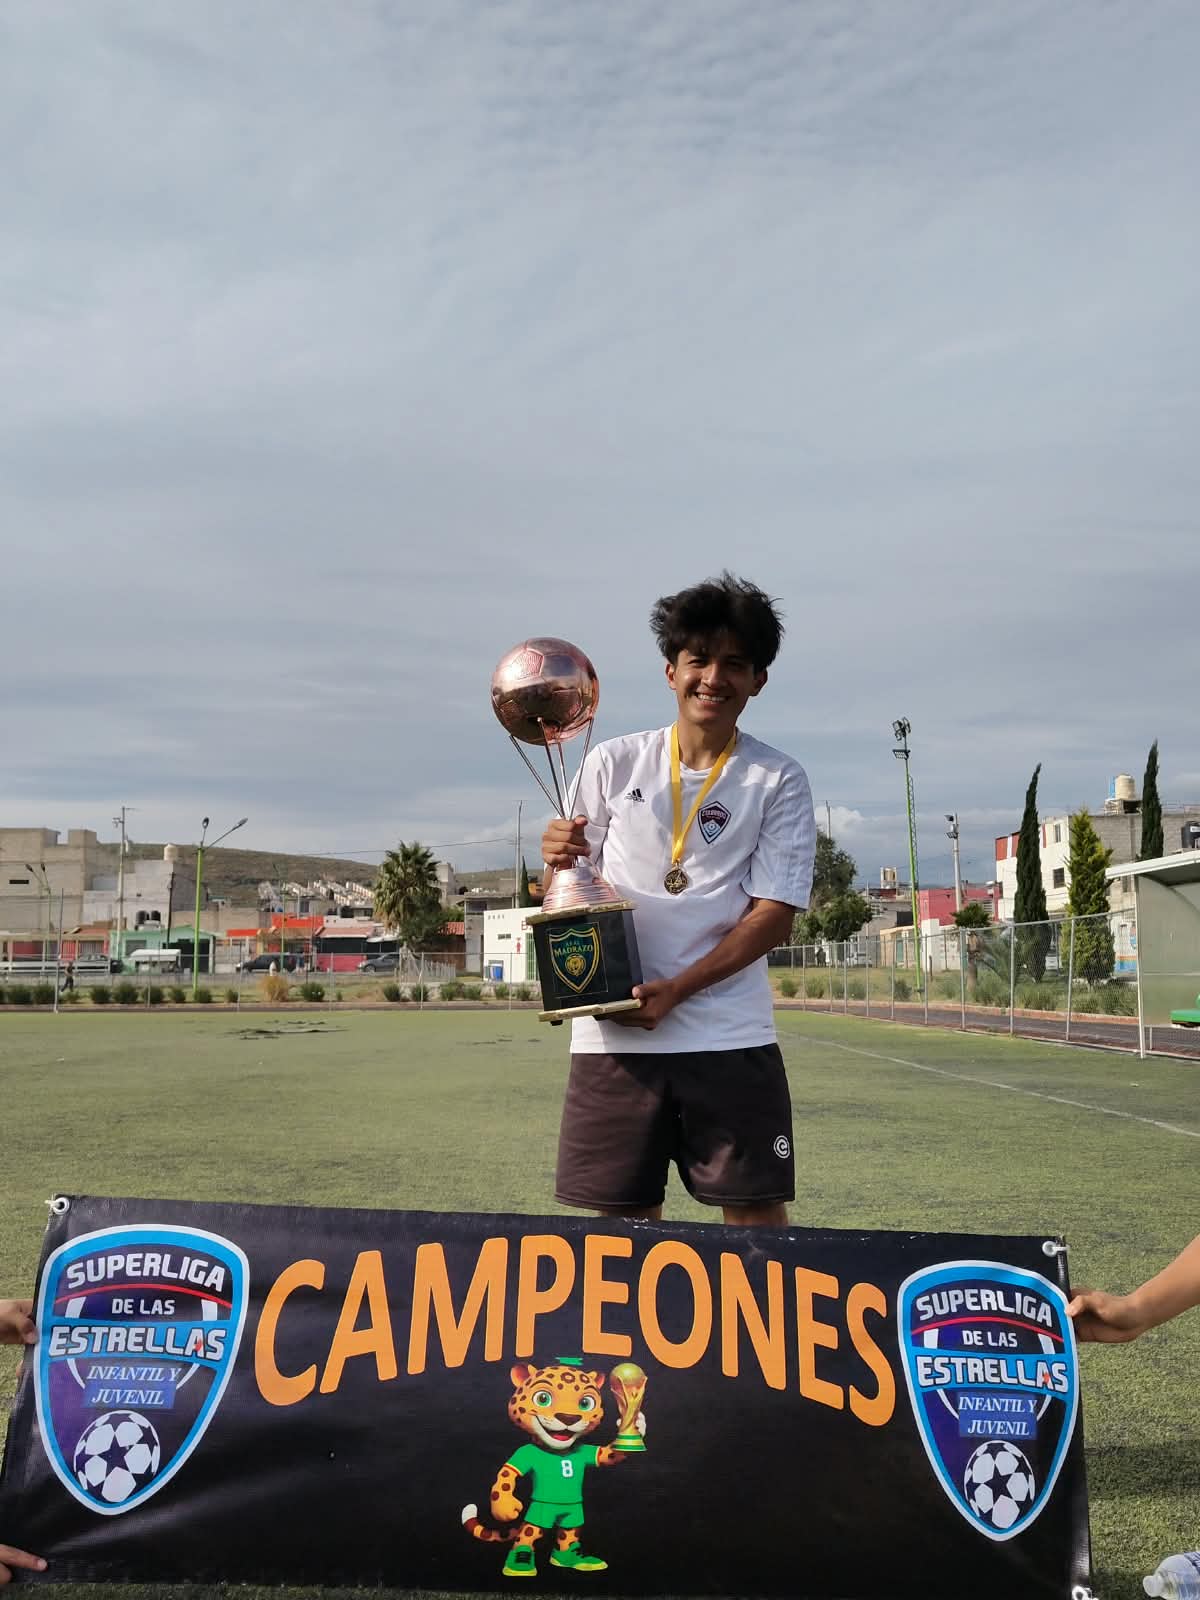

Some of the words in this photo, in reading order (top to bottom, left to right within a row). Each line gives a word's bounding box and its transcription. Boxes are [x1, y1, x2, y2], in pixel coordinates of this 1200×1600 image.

[66, 1253, 225, 1292] SUPERLIGA
[112, 1298, 134, 1314] DE
[140, 1299, 175, 1315] LAS
[916, 1289, 1052, 1327] SUPERLIGA
[254, 1234, 896, 1426] CAMPEONES
[963, 1330, 984, 1346] DE
[988, 1332, 1018, 1348] LAS
[49, 1326, 227, 1361] ESTRELLAS
[87, 1366, 166, 1381] INFANTIL
[167, 1367, 182, 1382] Y
[916, 1356, 1069, 1393] ESTRELLAS
[91, 1389, 164, 1405] JUVENIL
[958, 1396, 1026, 1413] INFANTIL
[1026, 1399, 1037, 1414] Y
[968, 1419, 1030, 1436] JUVENIL
[561, 1459, 574, 1478] 8
